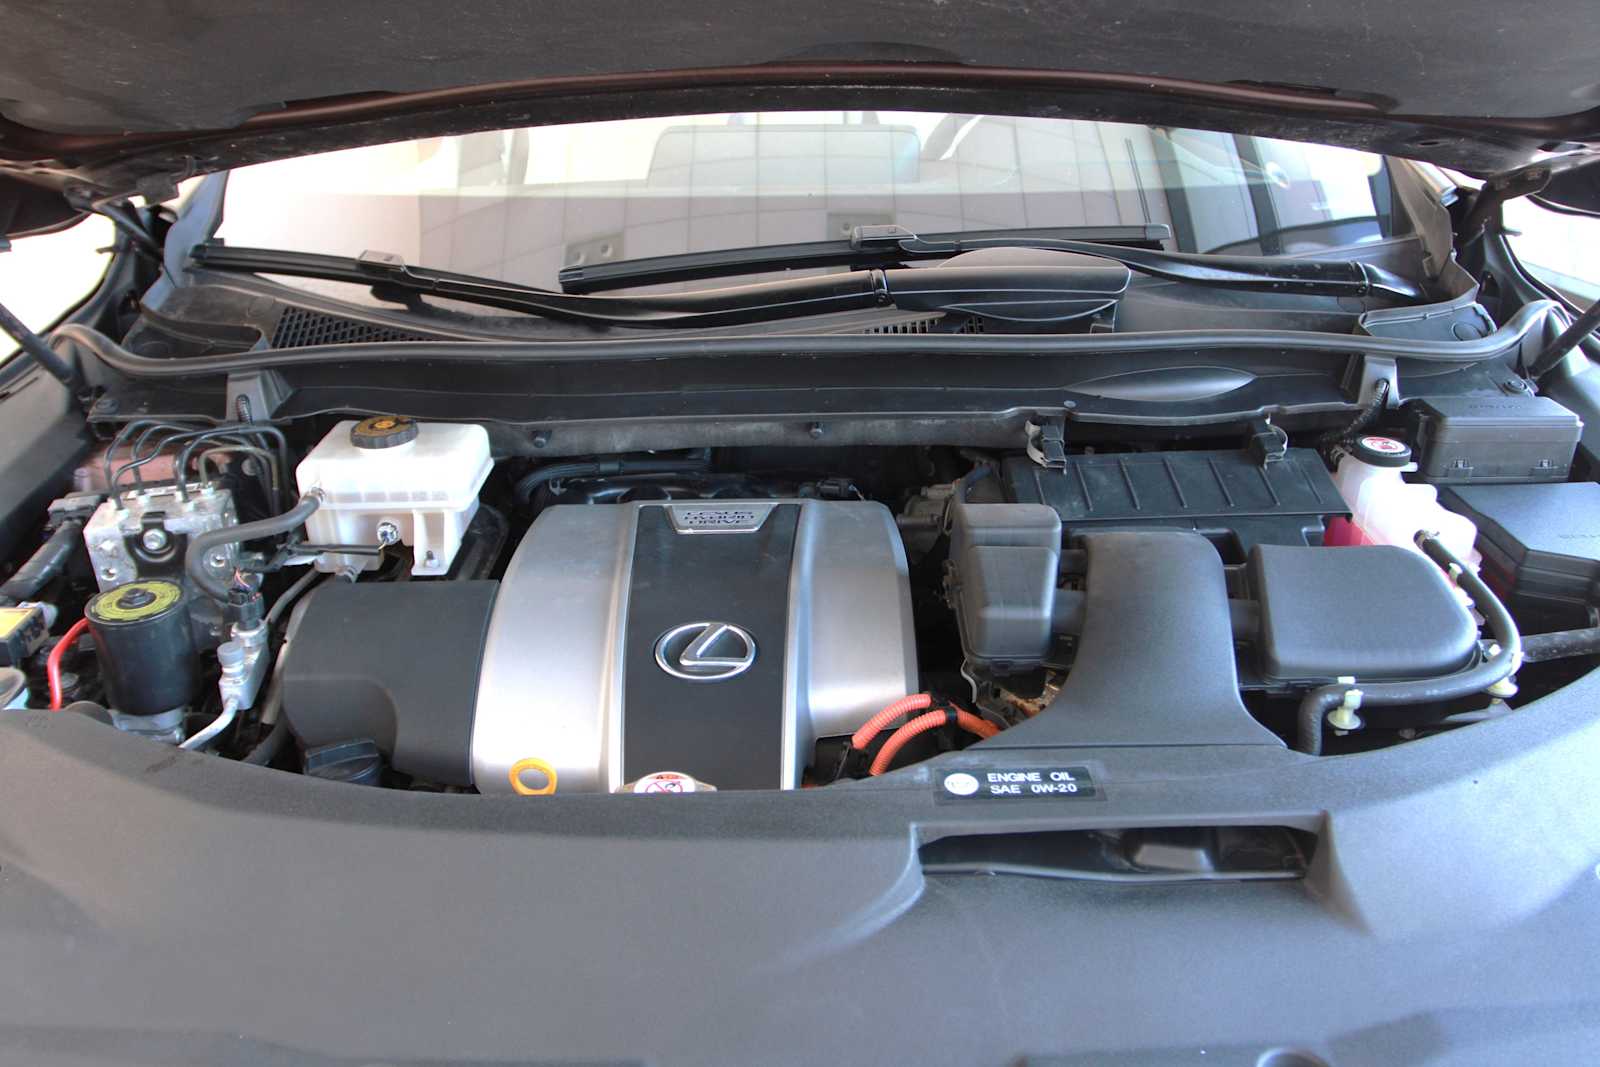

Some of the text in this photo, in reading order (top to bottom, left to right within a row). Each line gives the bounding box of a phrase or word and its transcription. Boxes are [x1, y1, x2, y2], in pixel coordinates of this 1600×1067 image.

[987, 771, 1075, 782] ENGINE OIL
[990, 783, 1077, 794] SAE 0W-20
